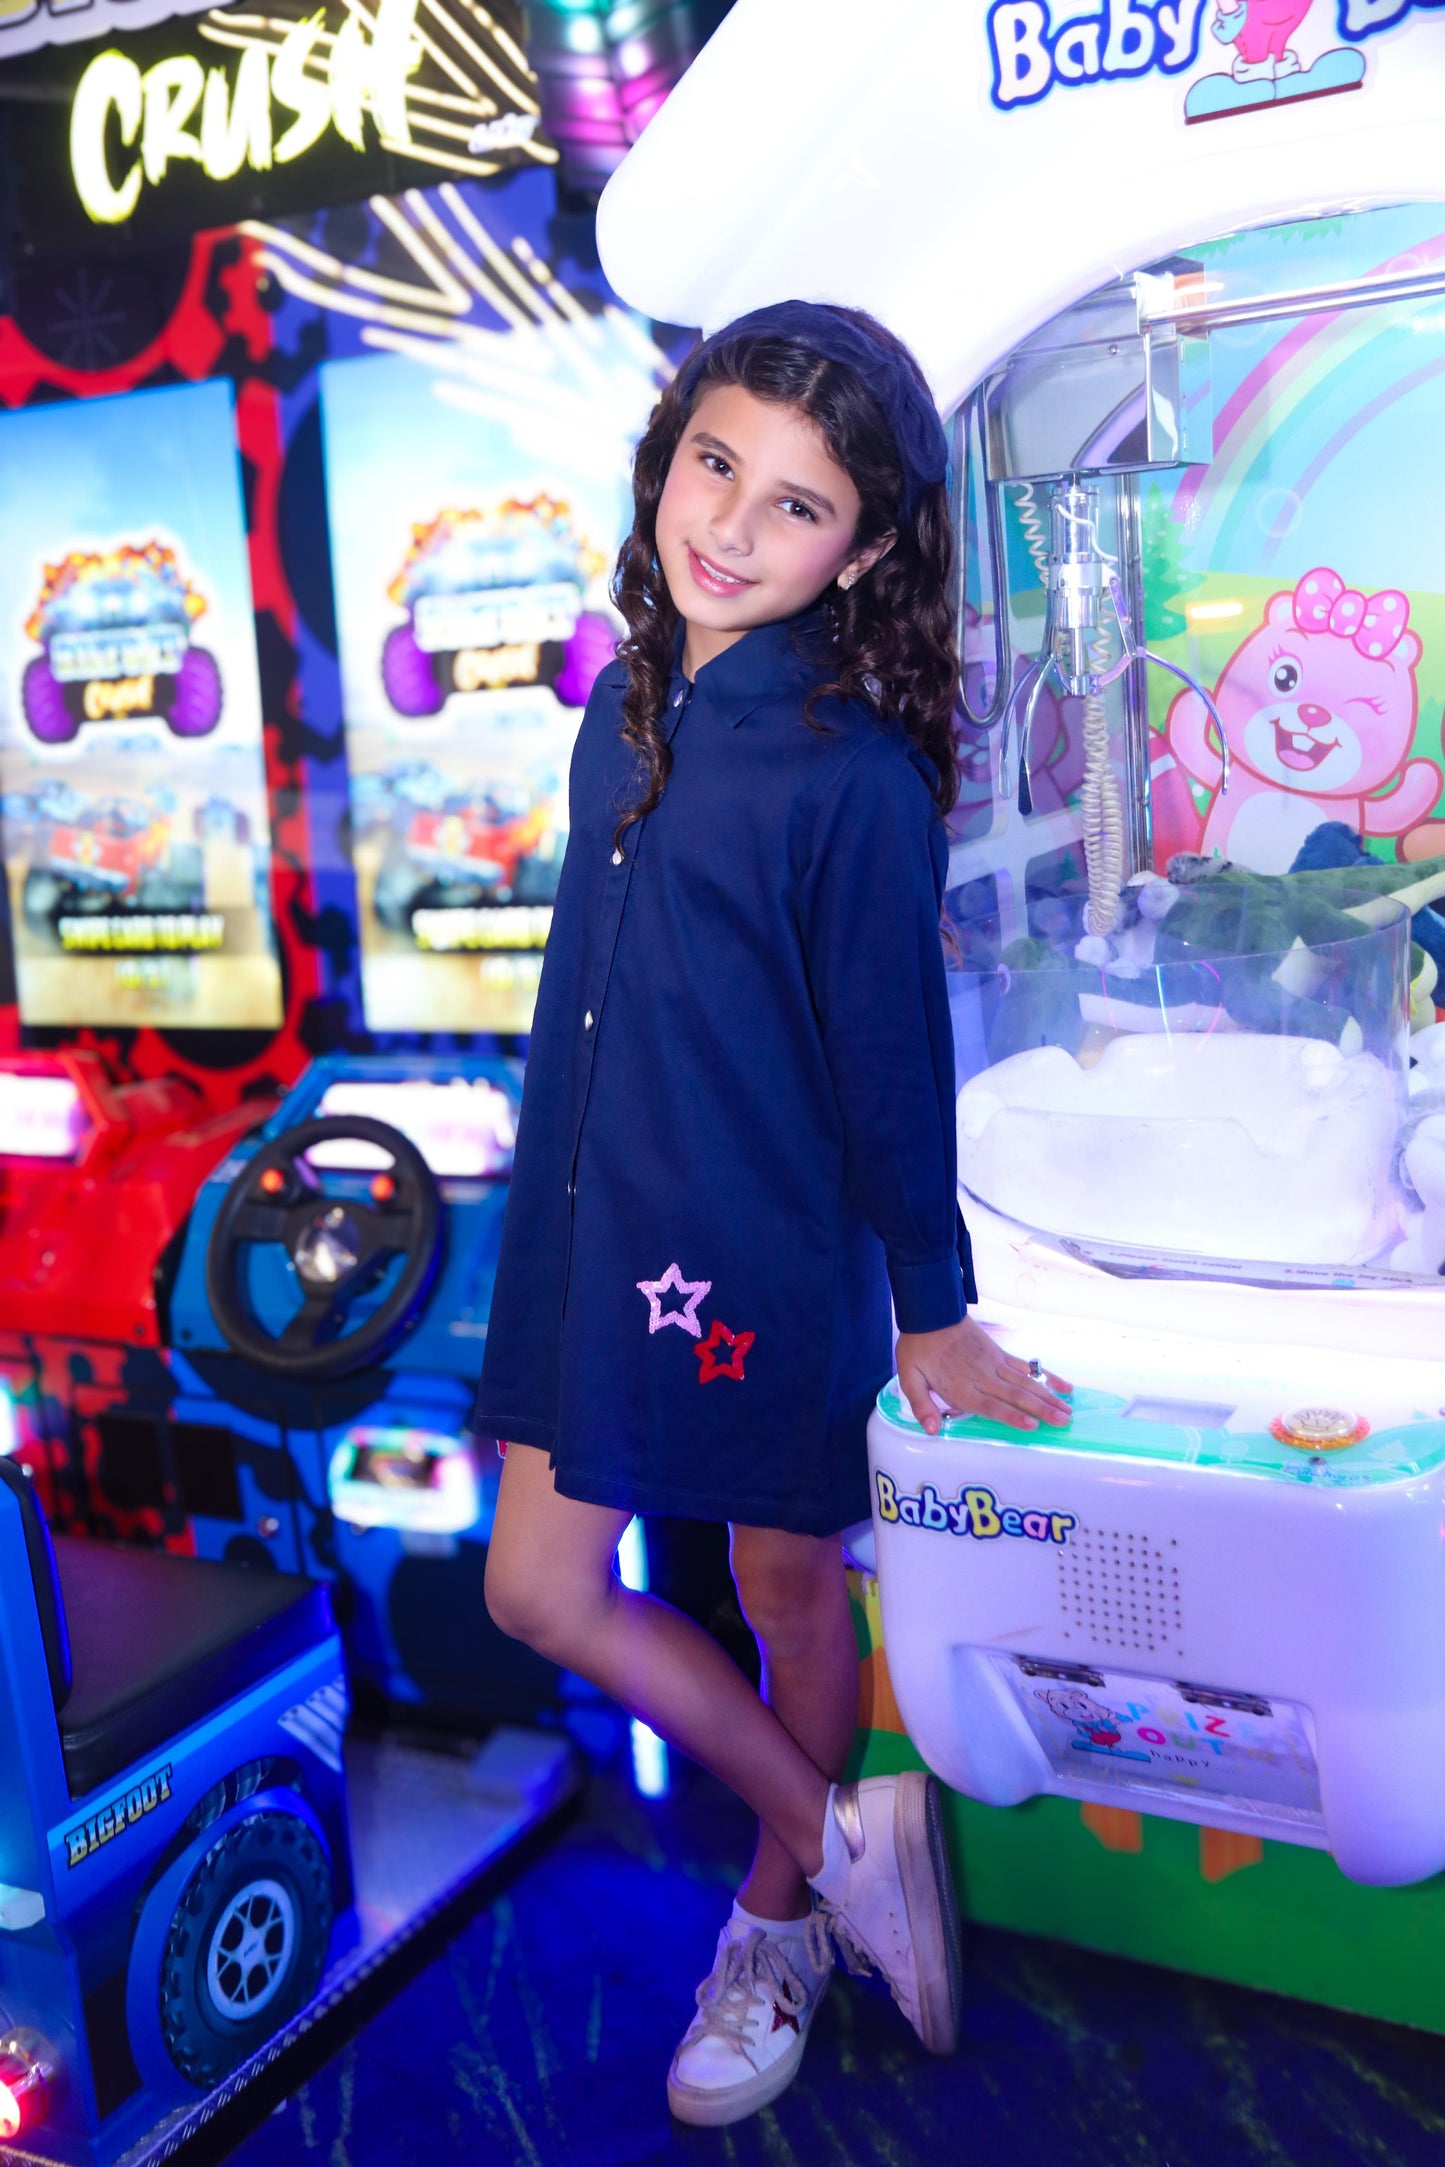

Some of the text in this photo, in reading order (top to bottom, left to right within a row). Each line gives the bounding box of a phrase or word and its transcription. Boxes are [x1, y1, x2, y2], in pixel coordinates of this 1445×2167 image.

[988, 0, 1206, 110] Baby
[70, 0, 424, 224] CRUSH
[876, 1469, 1076, 1544] BabyBear
[1136, 1726, 1226, 1756] OUT
[64, 1761, 172, 1868] BIGFOOT
